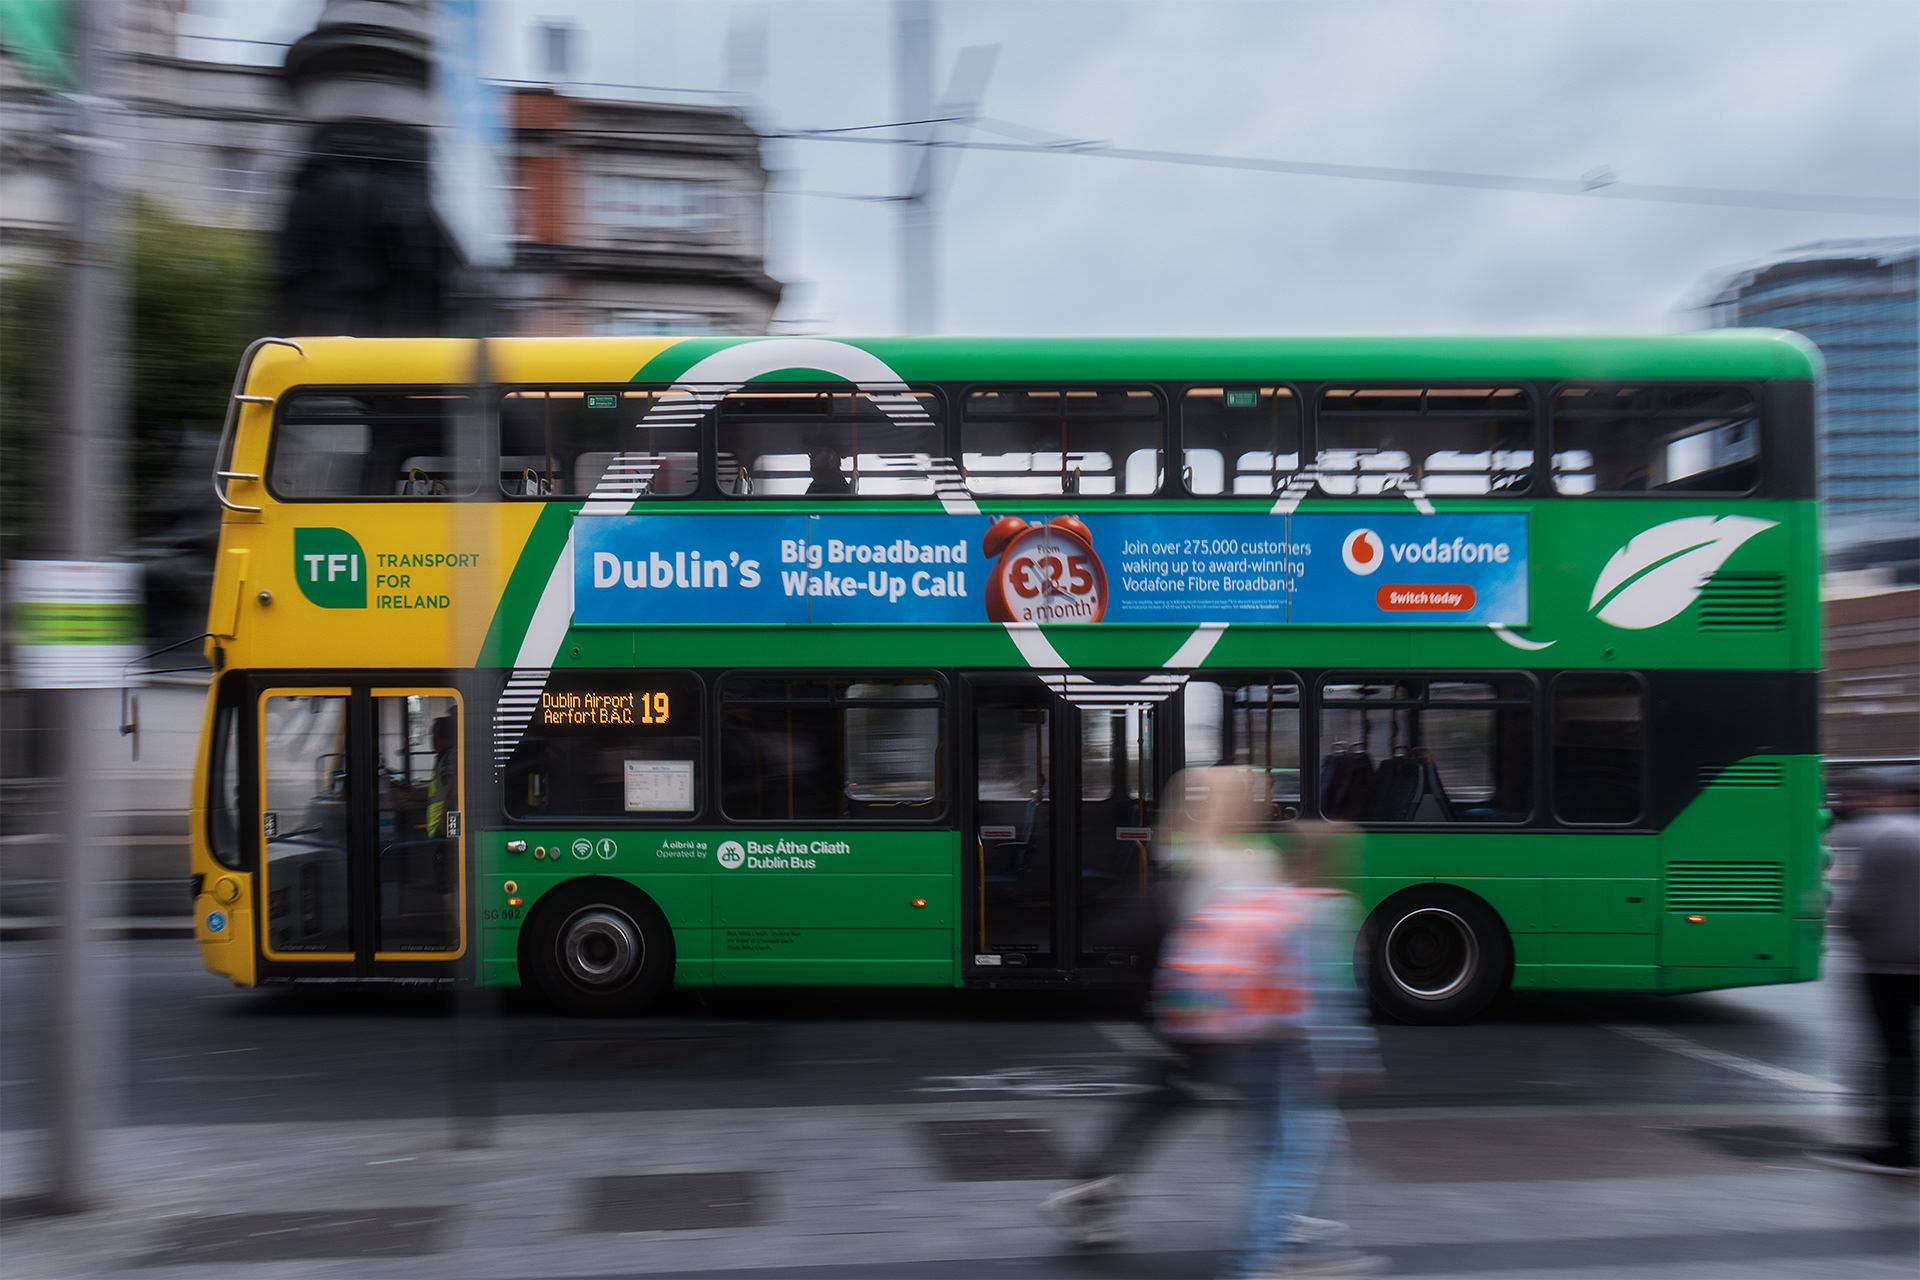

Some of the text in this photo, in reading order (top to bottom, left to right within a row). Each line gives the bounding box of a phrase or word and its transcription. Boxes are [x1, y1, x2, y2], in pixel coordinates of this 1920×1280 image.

[781, 540, 967, 569] Big Broadband
[1037, 545, 1060, 553] From
[1122, 539, 1311, 556] Join over 275,000 customers
[1390, 537, 1510, 563] vodafone
[303, 554, 358, 581] TFI
[377, 554, 480, 567] TRANSPORT
[1122, 558, 1305, 577] waking up to award-winning
[593, 551, 761, 588] Dublin’s
[1009, 555, 1093, 598] €25
[377, 575, 410, 588] FOR
[781, 571, 967, 603] Wake-Up Call
[1122, 576, 1297, 592] Vodafone Fibre Broadband.
[377, 595, 450, 609] IRELAND
[1390, 591, 1462, 607] Switch today
[1023, 607, 1032, 620] a
[543, 692, 634, 708] Dublin Airport
[641, 692, 669, 723] 19
[544, 708, 597, 723] Aerfort
[747, 838, 850, 854] Bus Átha Cliath
[656, 850, 707, 859] Operated by
[747, 856, 816, 869] Dublin Bus
[483, 908, 521, 920] SG 592
